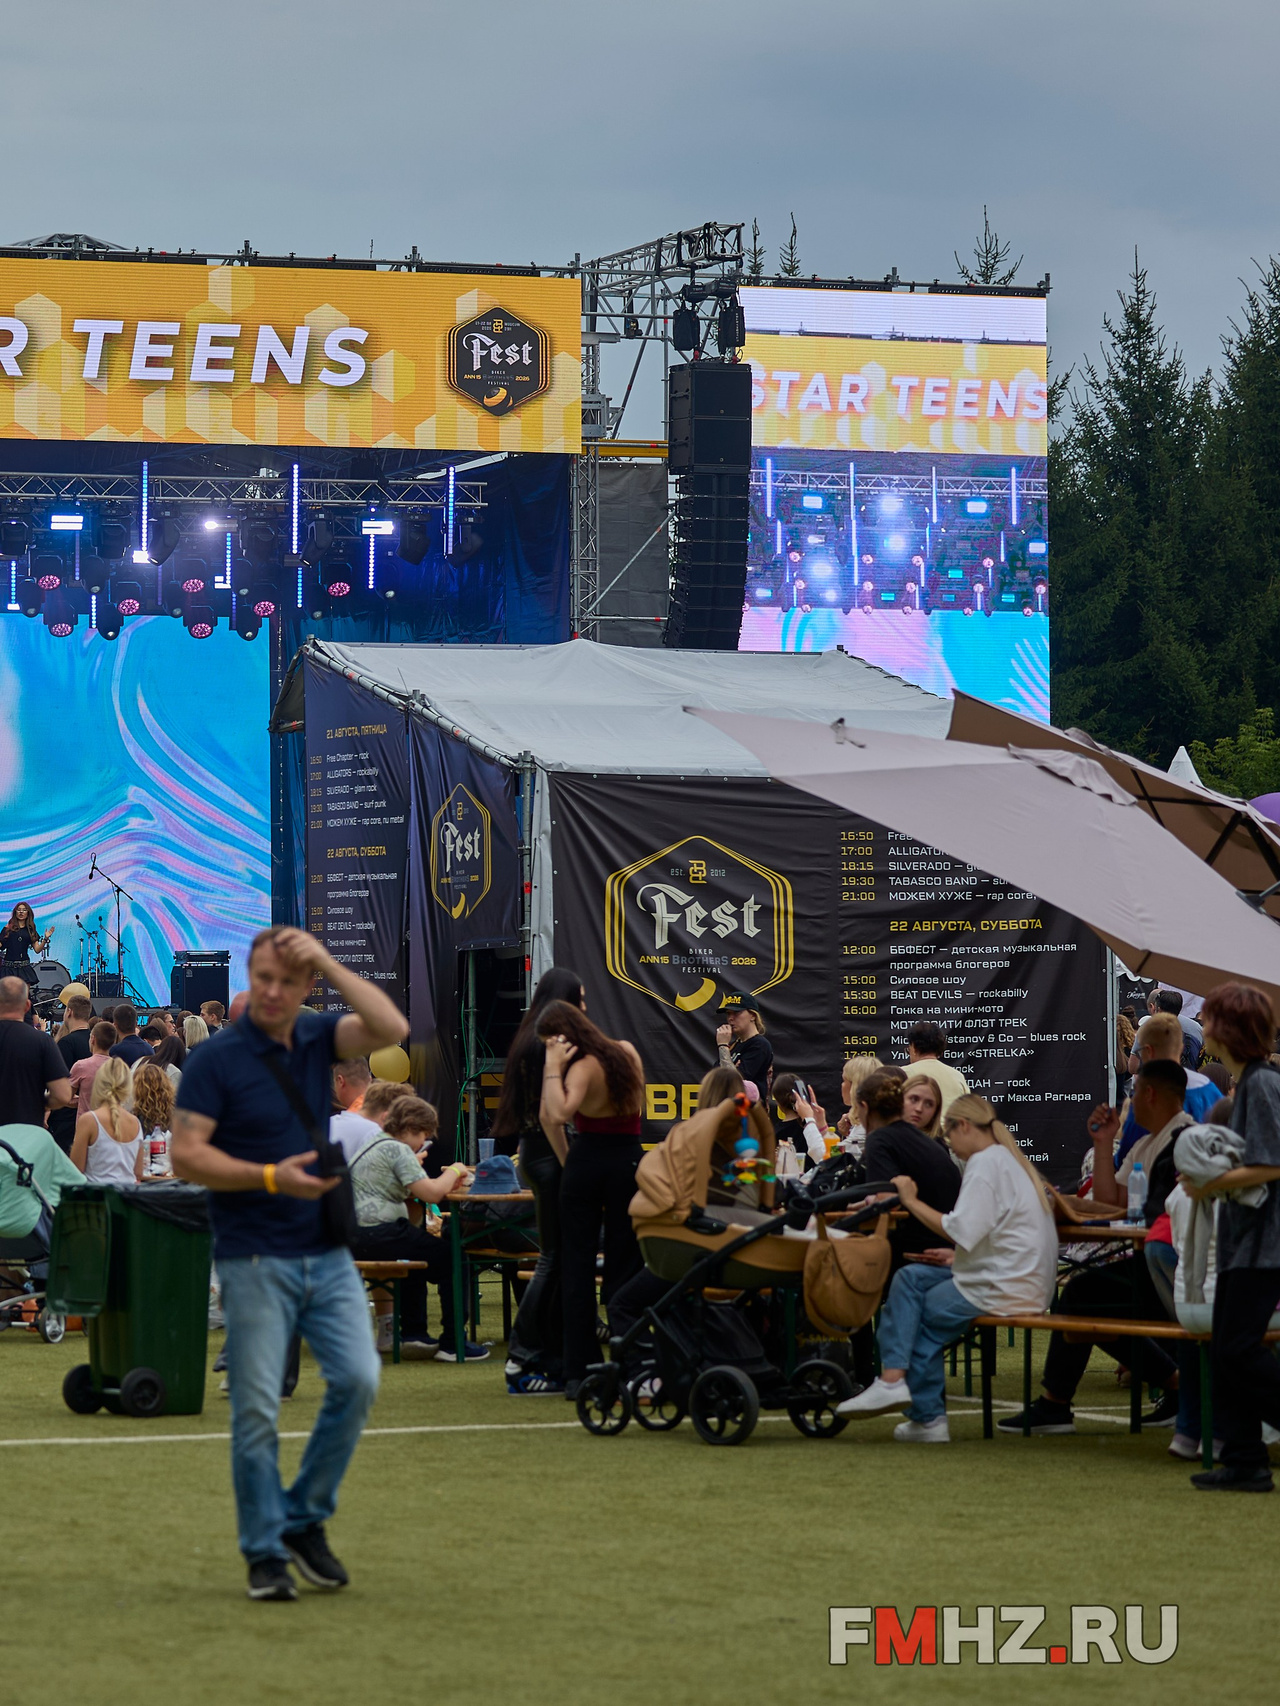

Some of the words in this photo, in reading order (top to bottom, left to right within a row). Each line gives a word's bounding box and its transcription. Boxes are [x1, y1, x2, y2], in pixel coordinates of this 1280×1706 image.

[72, 318, 370, 387] TEENS
[462, 332, 533, 372] Fest
[752, 370, 870, 413] STAR
[892, 376, 1046, 419] TEENS
[361, 724, 388, 736] ПЯТНИЦА
[840, 832, 874, 840] 16:50
[327, 849, 334, 858] 22
[360, 846, 386, 856] СУББОТА
[441, 822, 480, 872] Fest
[841, 847, 873, 856] 17:00
[842, 862, 874, 870] 18:15
[889, 862, 951, 870] SILVERADO
[842, 877, 875, 886] 19:30
[889, 877, 942, 886] TABASCO
[946, 876, 977, 885] BAND
[842, 892, 875, 901] 21:00
[889, 892, 935, 900] МОЖЕМ
[938, 892, 972, 900] ХУЖЕ
[987, 893, 1004, 901] rap
[636, 884, 762, 949] Fest
[890, 921, 907, 932] 22
[912, 920, 976, 932] АВГУСТА,
[981, 919, 1042, 931] СУББОТА
[843, 946, 876, 954] 12:00
[890, 945, 936, 954] ББФЕСТ
[952, 946, 999, 955] детская
[1003, 943, 1077, 954] музыкальная
[639, 956, 669, 964] ANN15
[731, 957, 756, 965] 2026
[890, 962, 952, 970] программа
[956, 960, 1010, 970] блогеров
[843, 976, 876, 985] 15:00
[890, 975, 939, 985] Силовое
[943, 976, 966, 986] шоу
[843, 991, 876, 1000] 15:30
[890, 990, 918, 999] BEAT
[922, 990, 962, 999] DEVILS
[979, 988, 1028, 999] rockabilly
[844, 1006, 877, 1015] 16:00
[890, 1005, 923, 1014] Гонка
[944, 1005, 1004, 1014] мини-мото
[965, 1019, 995, 1028] ФЛЭТ
[999, 1018, 1027, 1027] ТРЕК
[844, 1036, 877, 1045] 16:30
[998, 1034, 1014, 1042] Co
[1030, 1032, 1058, 1042] blues
[1062, 1032, 1086, 1041] rock
[944, 1050, 964, 1058] бои
[1008, 1078, 1031, 1087] rock
[1008, 1093, 1041, 1102] Макса
[1045, 1092, 1092, 1102] Рагнара
